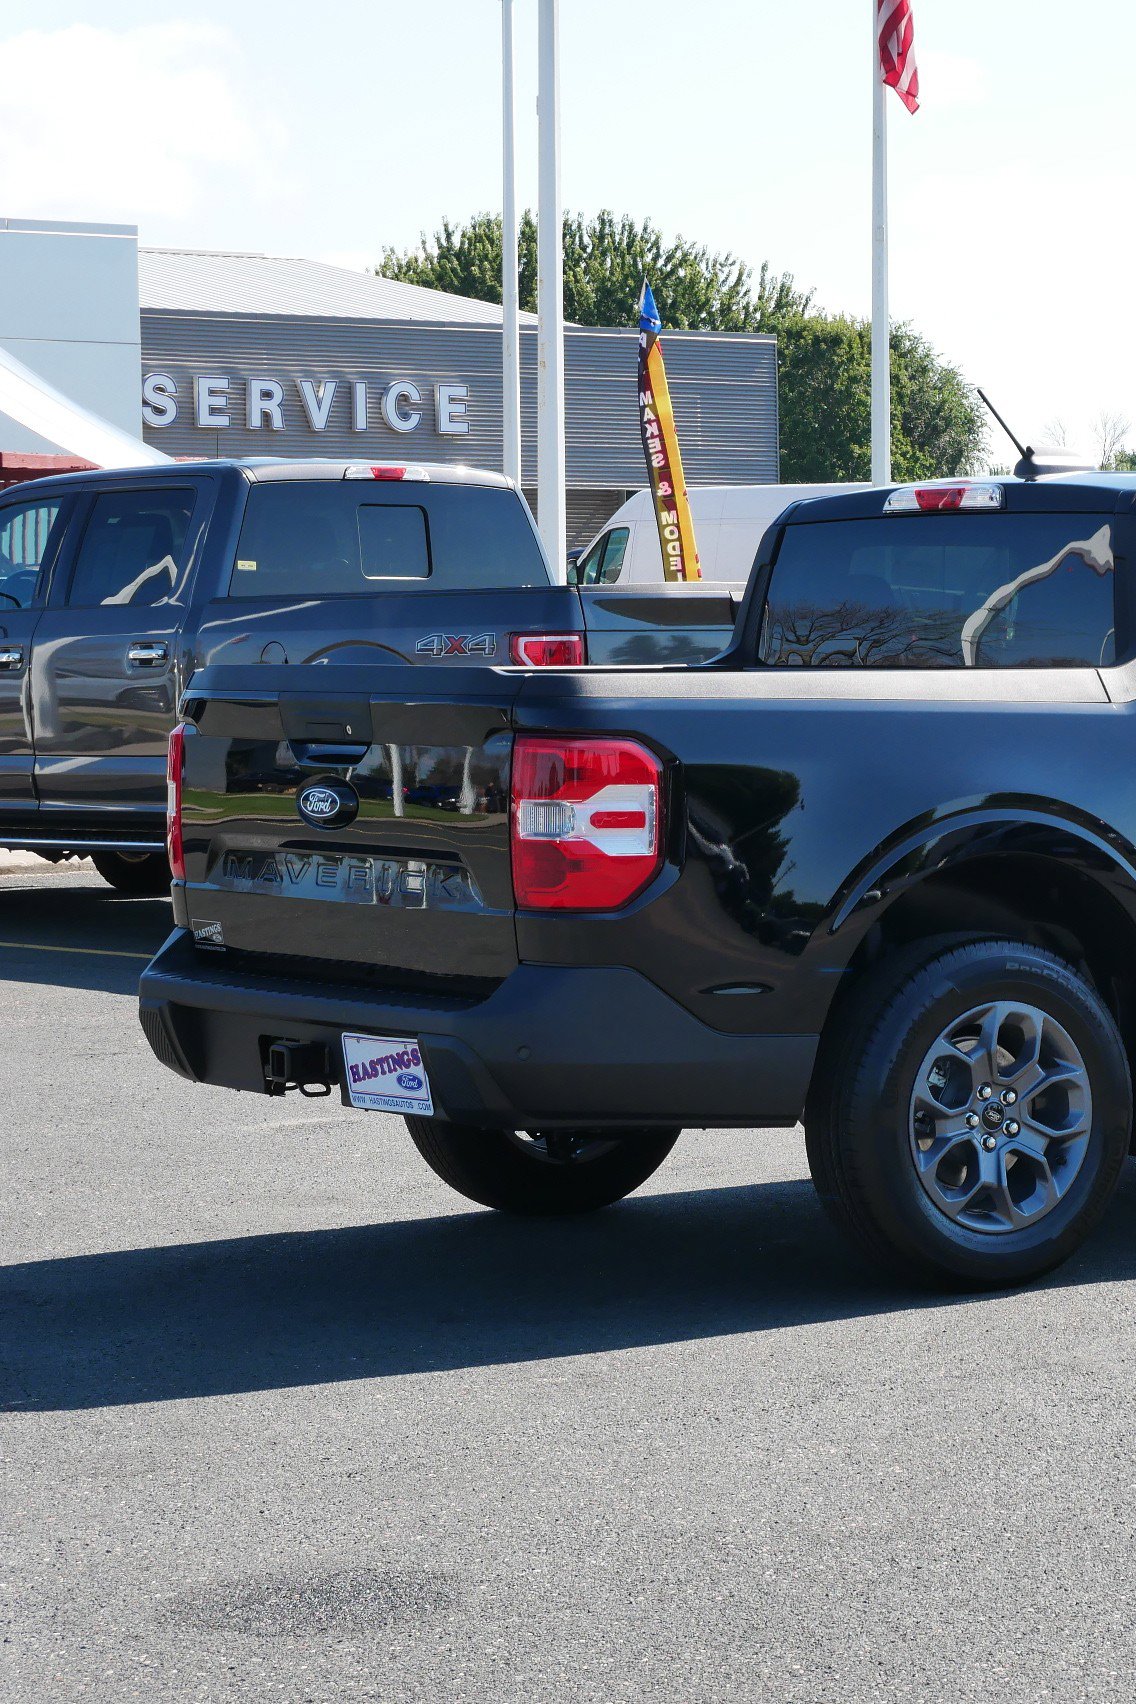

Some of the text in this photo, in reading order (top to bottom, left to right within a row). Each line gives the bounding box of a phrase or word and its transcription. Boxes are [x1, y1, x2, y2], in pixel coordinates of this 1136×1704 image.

[142, 372, 471, 434] SERVICE
[305, 790, 333, 813] Ford
[225, 854, 465, 899] MAVERICK
[349, 1047, 421, 1083] HASTINGS
[400, 1074, 420, 1089] Ford
